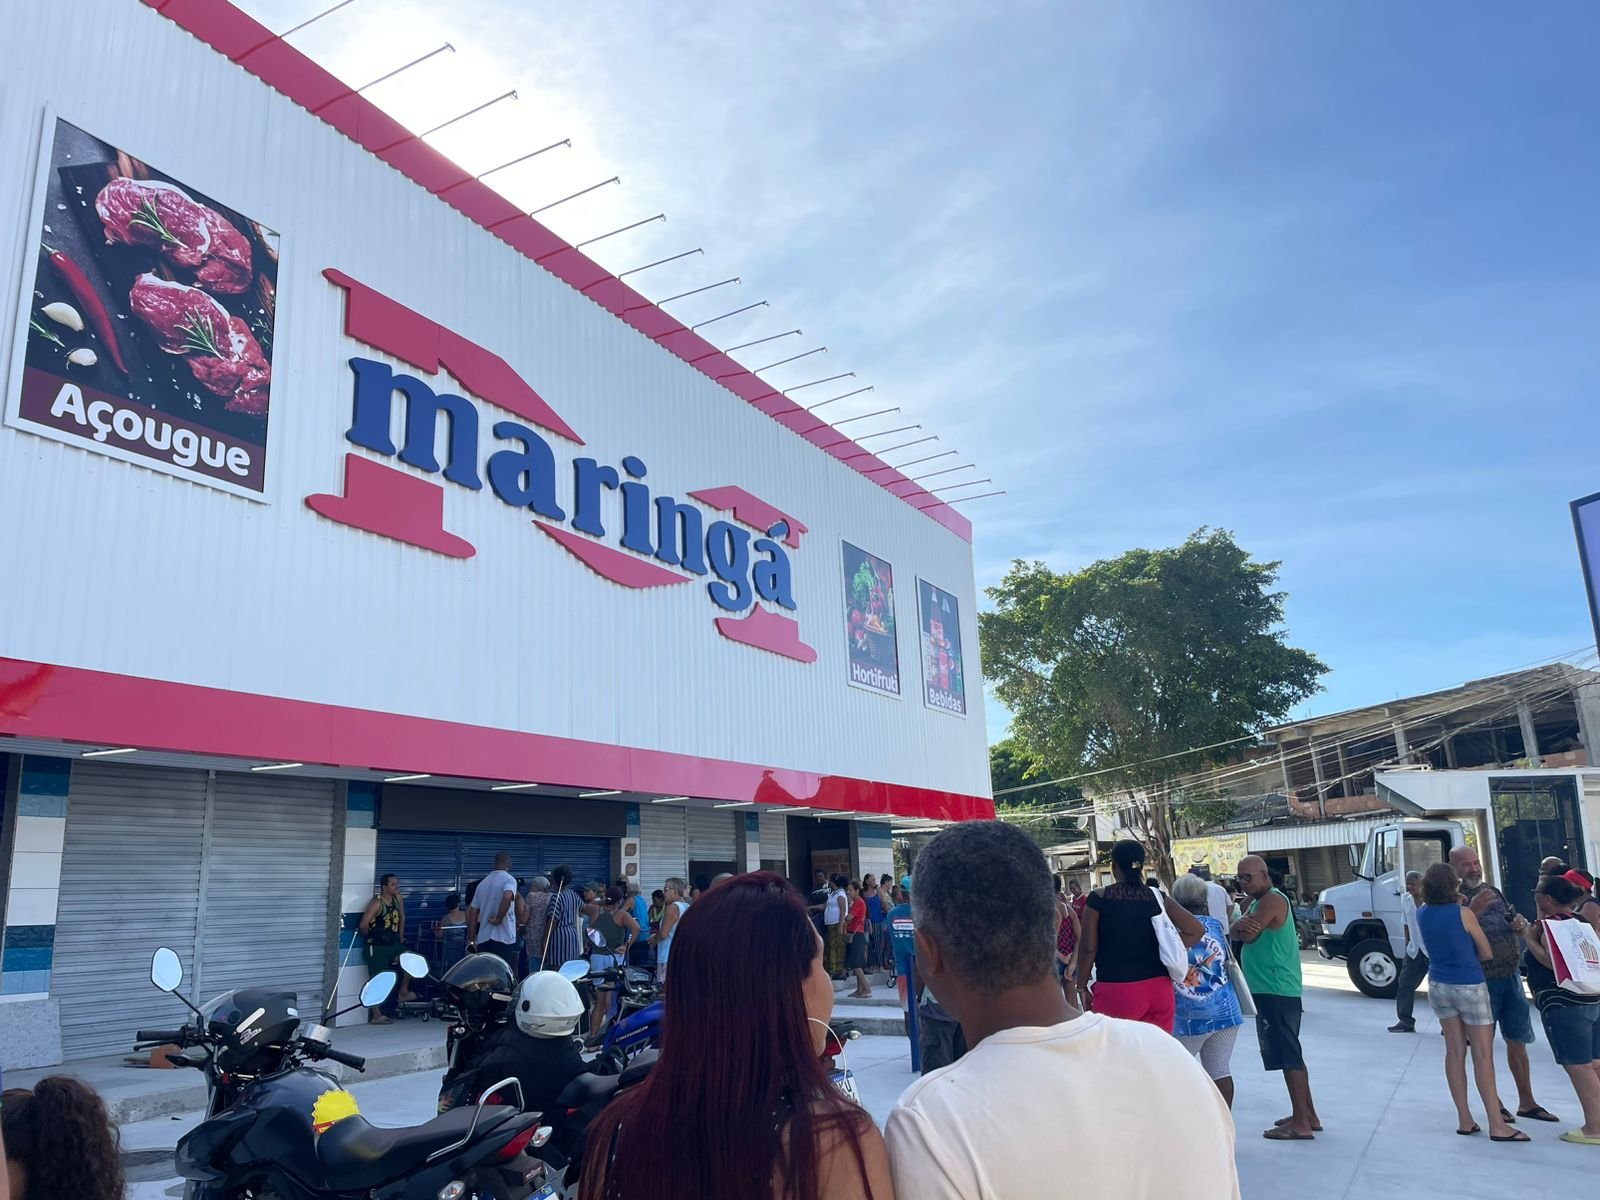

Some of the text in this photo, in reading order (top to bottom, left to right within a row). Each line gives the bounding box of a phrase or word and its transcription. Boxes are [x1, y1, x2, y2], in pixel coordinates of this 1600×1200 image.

[50, 383, 250, 476] Açougue
[345, 356, 797, 611] maringá
[852, 662, 898, 693] Hortifruti
[929, 688, 961, 712] Bebidas
